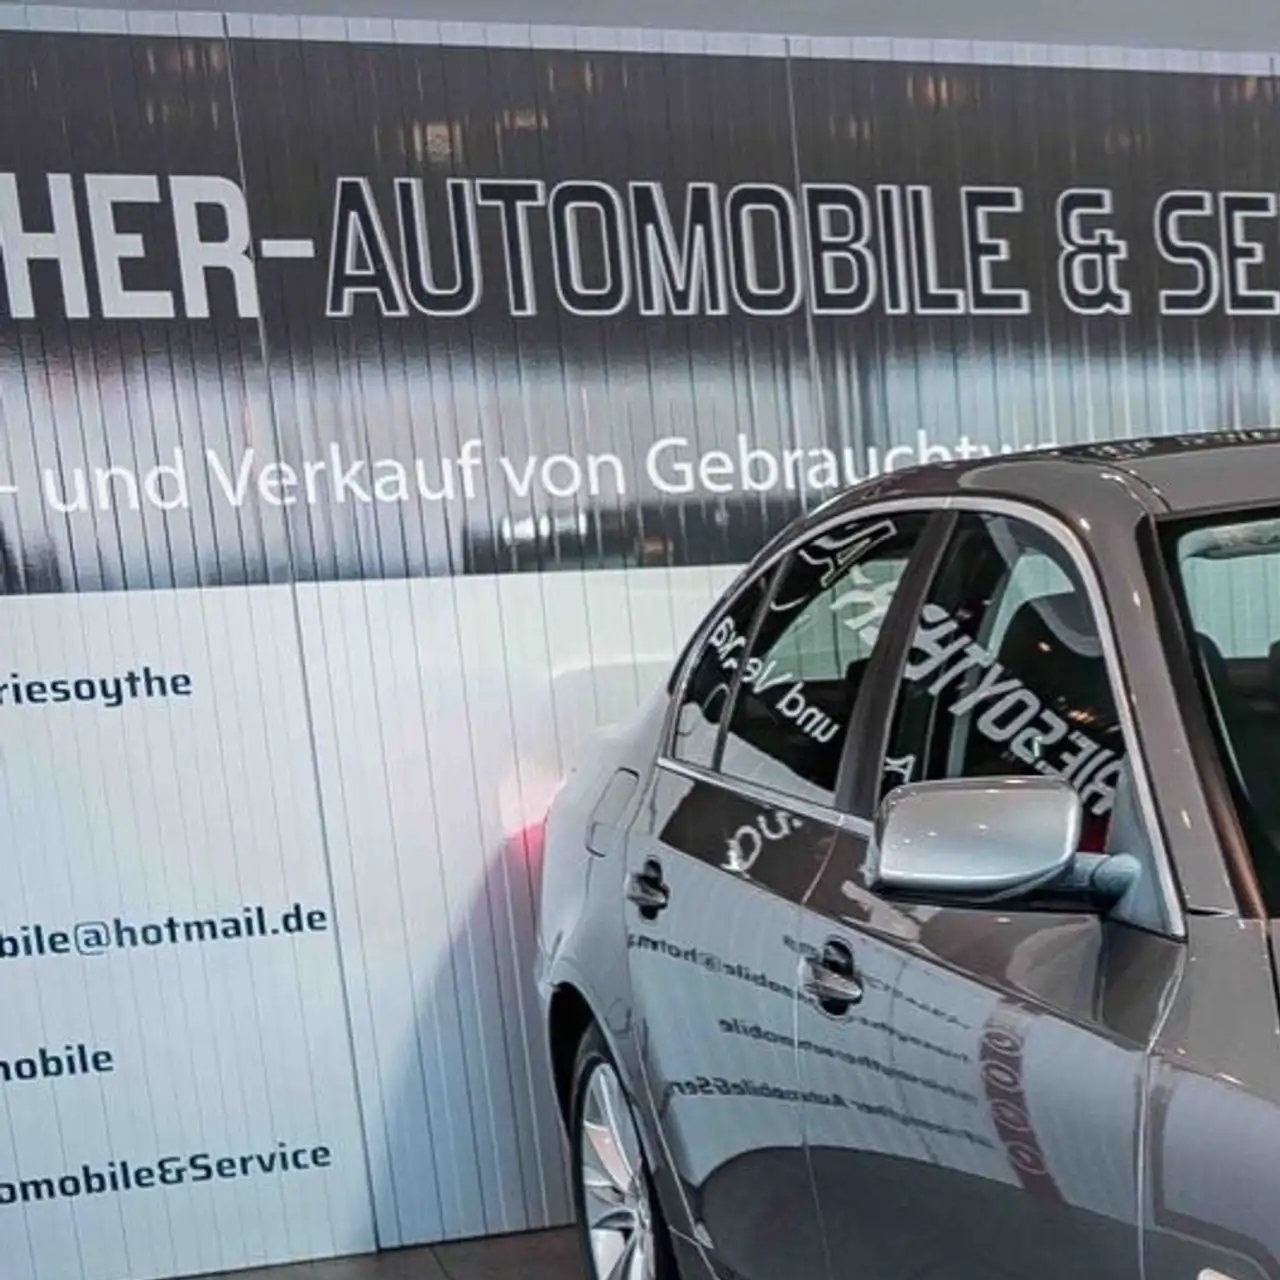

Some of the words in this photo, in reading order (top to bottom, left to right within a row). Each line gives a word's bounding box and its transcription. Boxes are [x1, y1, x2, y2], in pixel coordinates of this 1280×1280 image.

[1057, 188, 1131, 315] &
[43, 446, 189, 513] und
[206, 438, 483, 507] Verkauf
[500, 450, 627, 499] von
